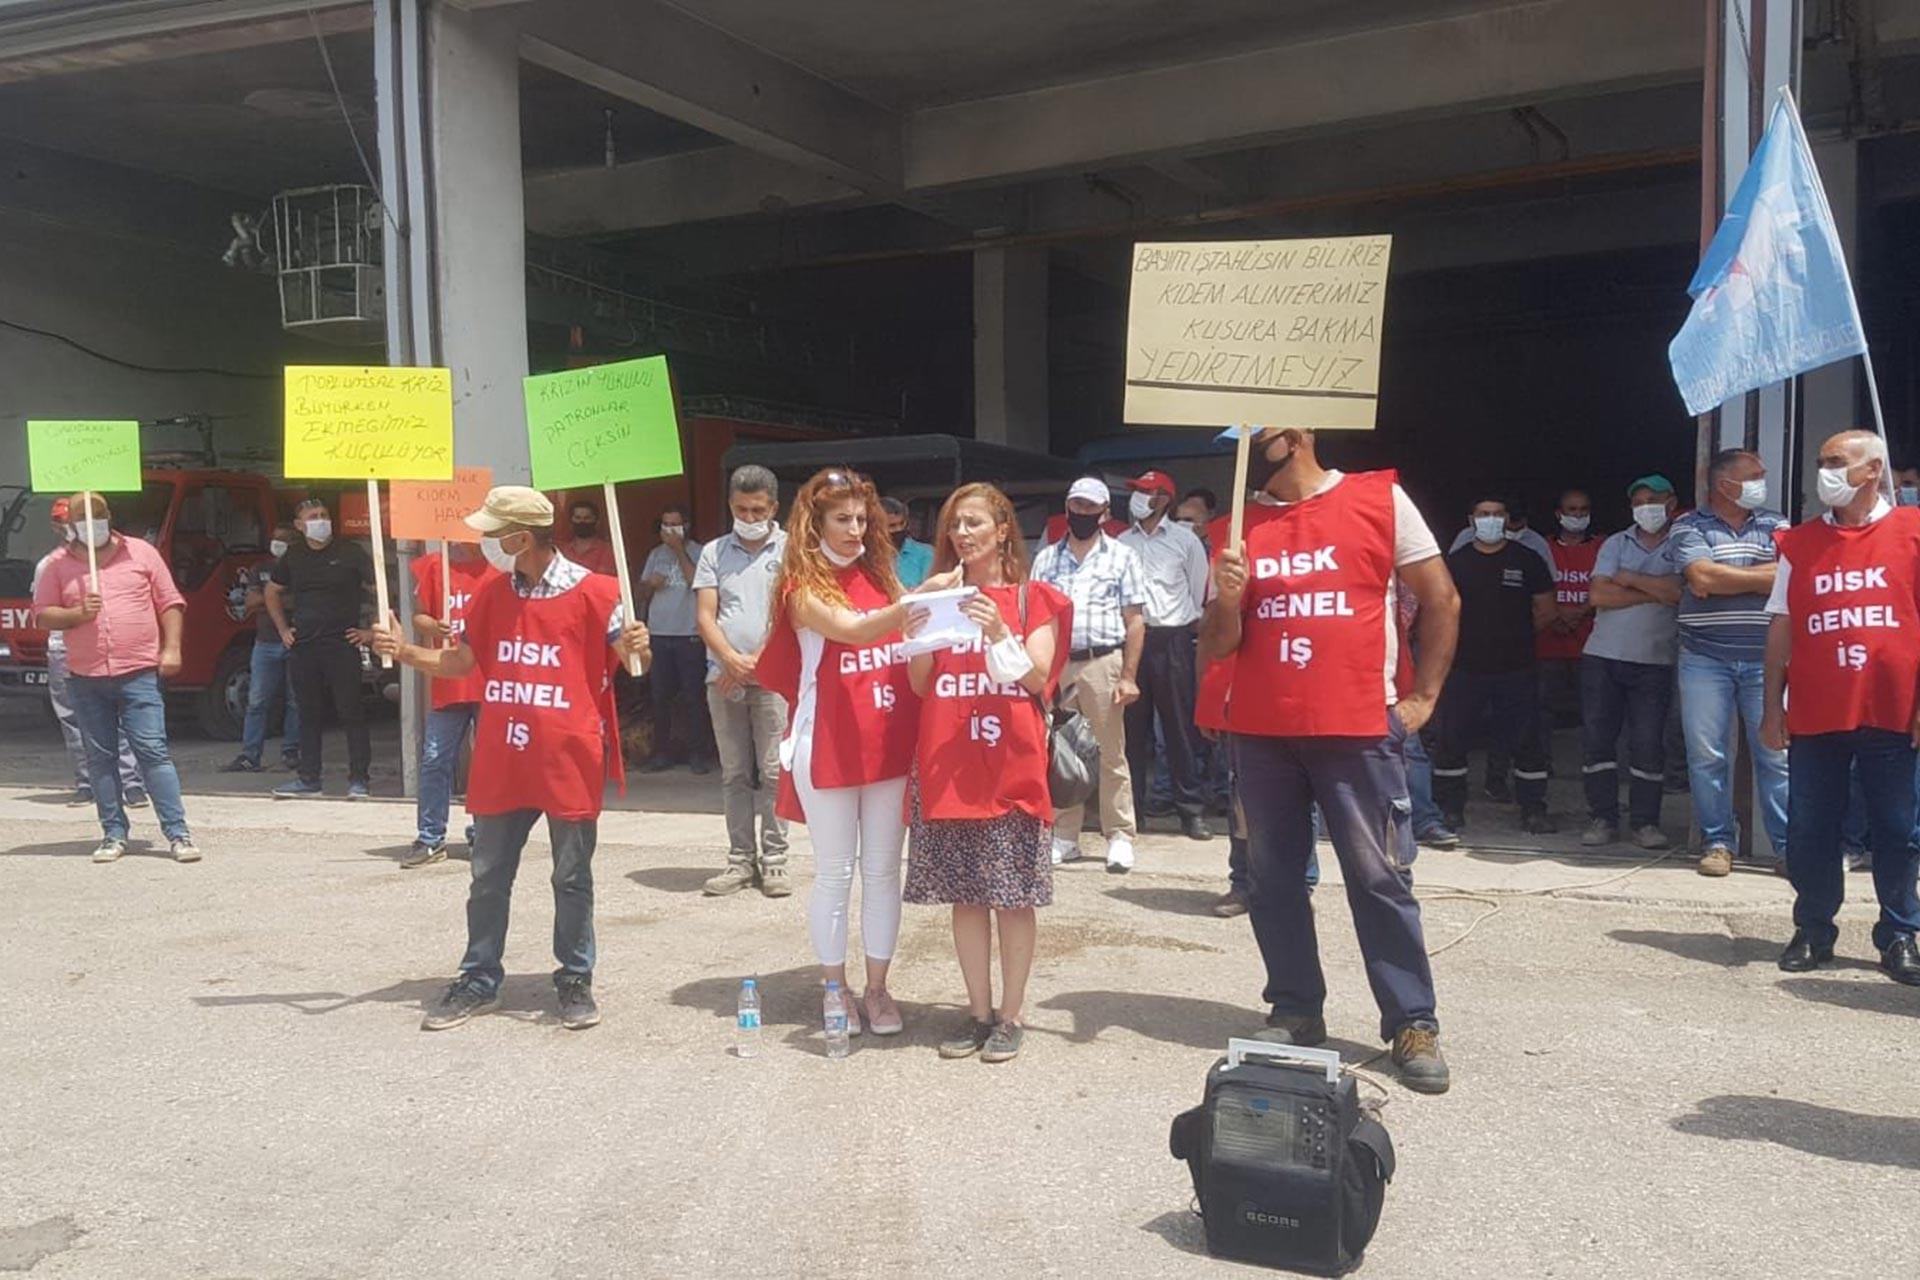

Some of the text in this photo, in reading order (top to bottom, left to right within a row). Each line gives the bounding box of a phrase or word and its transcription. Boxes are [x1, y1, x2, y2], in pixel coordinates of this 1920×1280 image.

[1158, 282, 1226, 305] KIDEM
[1182, 315, 1375, 344] KUSURA BAKMA
[1256, 546, 1339, 580] DİSK
[1815, 565, 1888, 595] DİSK
[1257, 591, 1354, 619] GENEL
[1808, 605, 1900, 635] GENEL
[497, 637, 562, 667] DİSK
[1280, 632, 1313, 669] İŞ
[1837, 641, 1868, 671] İŞ
[485, 680, 570, 709] GENEL
[872, 681, 896, 712] İŞ
[506, 717, 530, 751] İŞ
[970, 709, 1001, 747] İŞ
